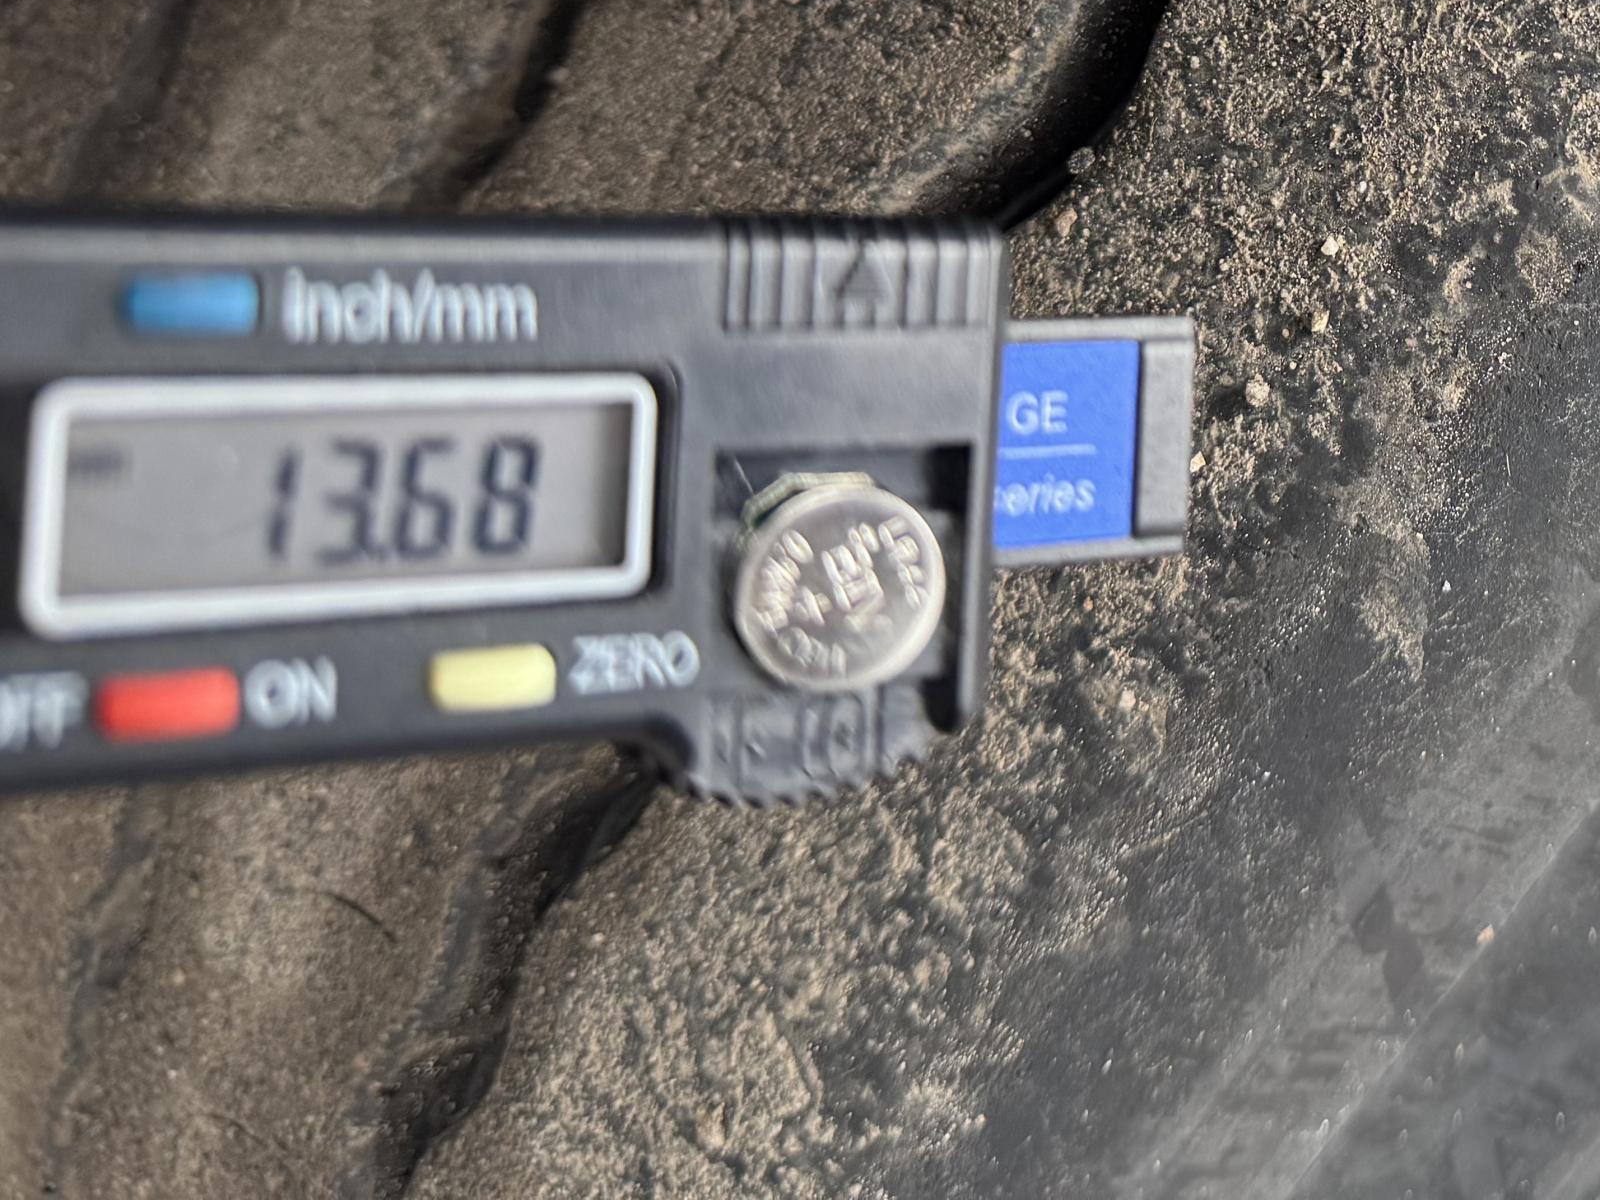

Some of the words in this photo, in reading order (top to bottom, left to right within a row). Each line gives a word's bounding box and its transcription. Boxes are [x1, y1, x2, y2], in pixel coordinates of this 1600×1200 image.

[283, 266, 539, 343] Inch/mm
[243, 654, 338, 728] ON
[567, 630, 699, 696] ZERO
